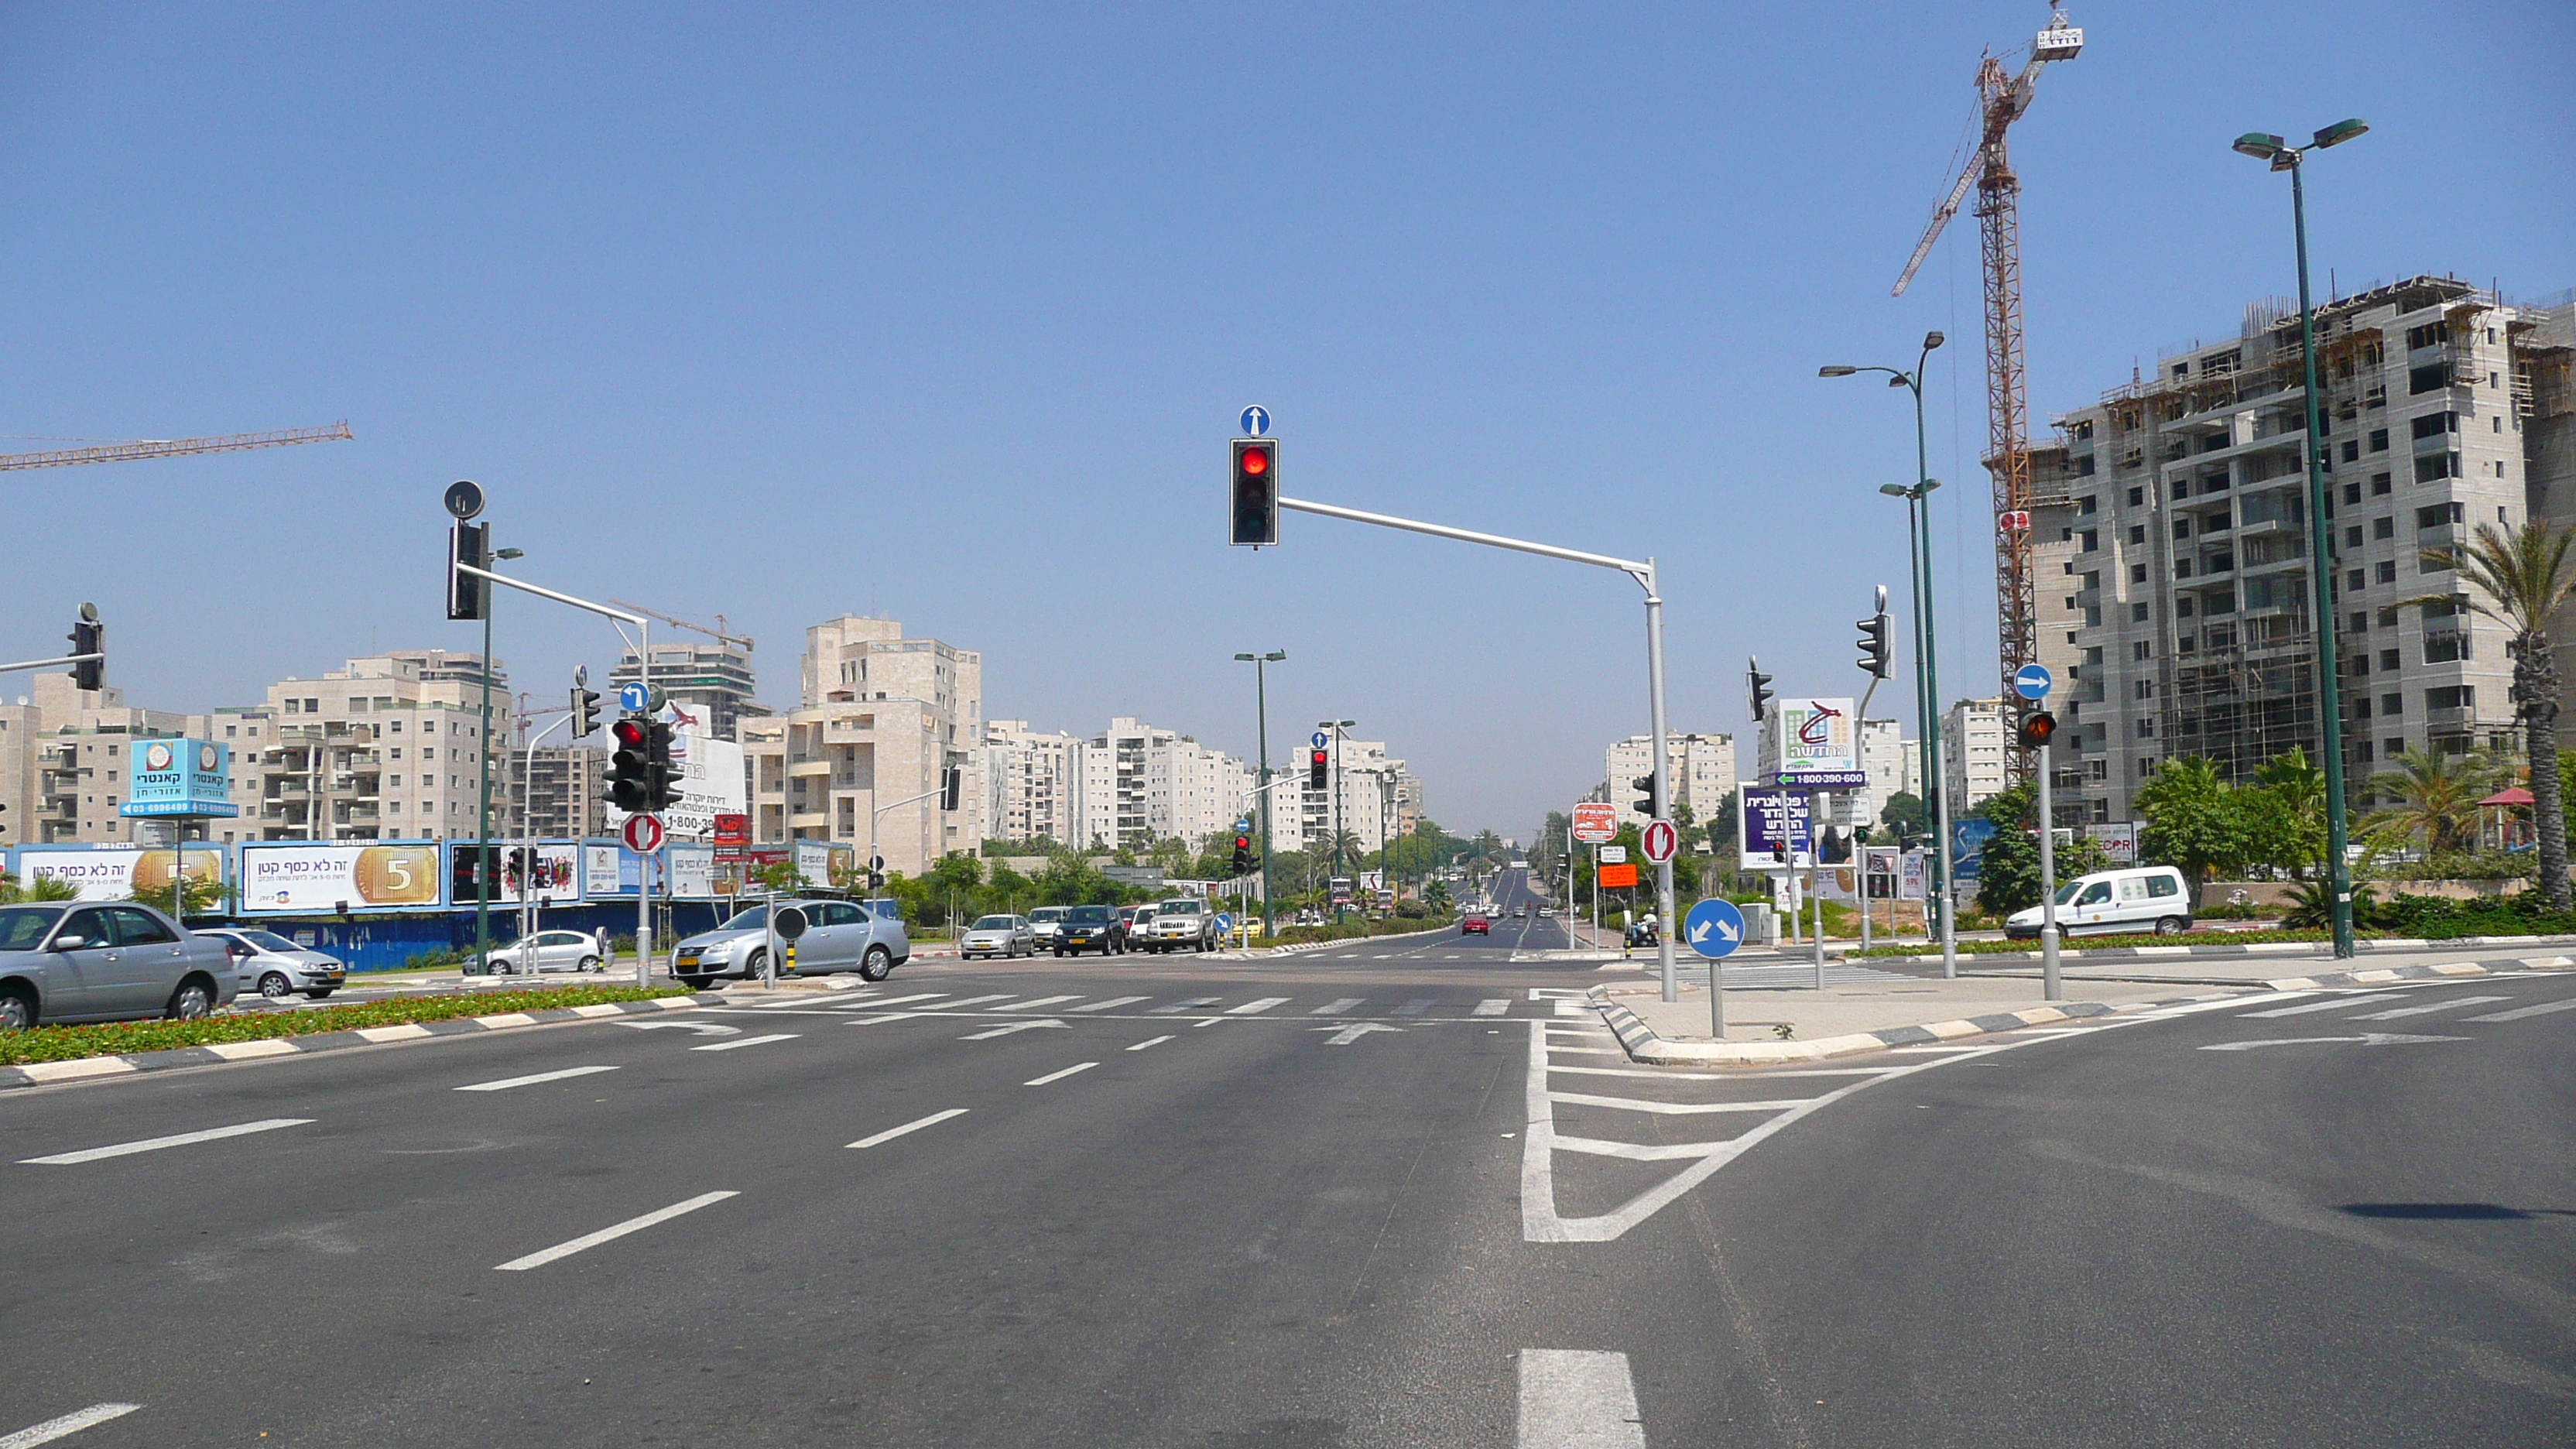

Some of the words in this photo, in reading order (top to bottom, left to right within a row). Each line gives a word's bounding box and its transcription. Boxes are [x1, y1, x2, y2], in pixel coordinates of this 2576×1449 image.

[1790, 745, 1848, 757] החדשה
[137, 773, 181, 785] קאנטרי
[194, 773, 224, 786] קאנטרי
[1797, 774, 1863, 783] 1-800-390-600
[686, 793, 706, 804] יוקרה
[1790, 807, 1808, 817] של
[90, 863, 108, 876] לא
[111, 865, 126, 876] זה
[259, 862, 279, 875] קטן
[284, 862, 309, 875] כסף
[313, 858, 331, 871] לא
[334, 861, 348, 871] זה
[60, 866, 86, 878] כסף
[386, 859, 412, 891] 5
[2046, 886, 2051, 896] 7
